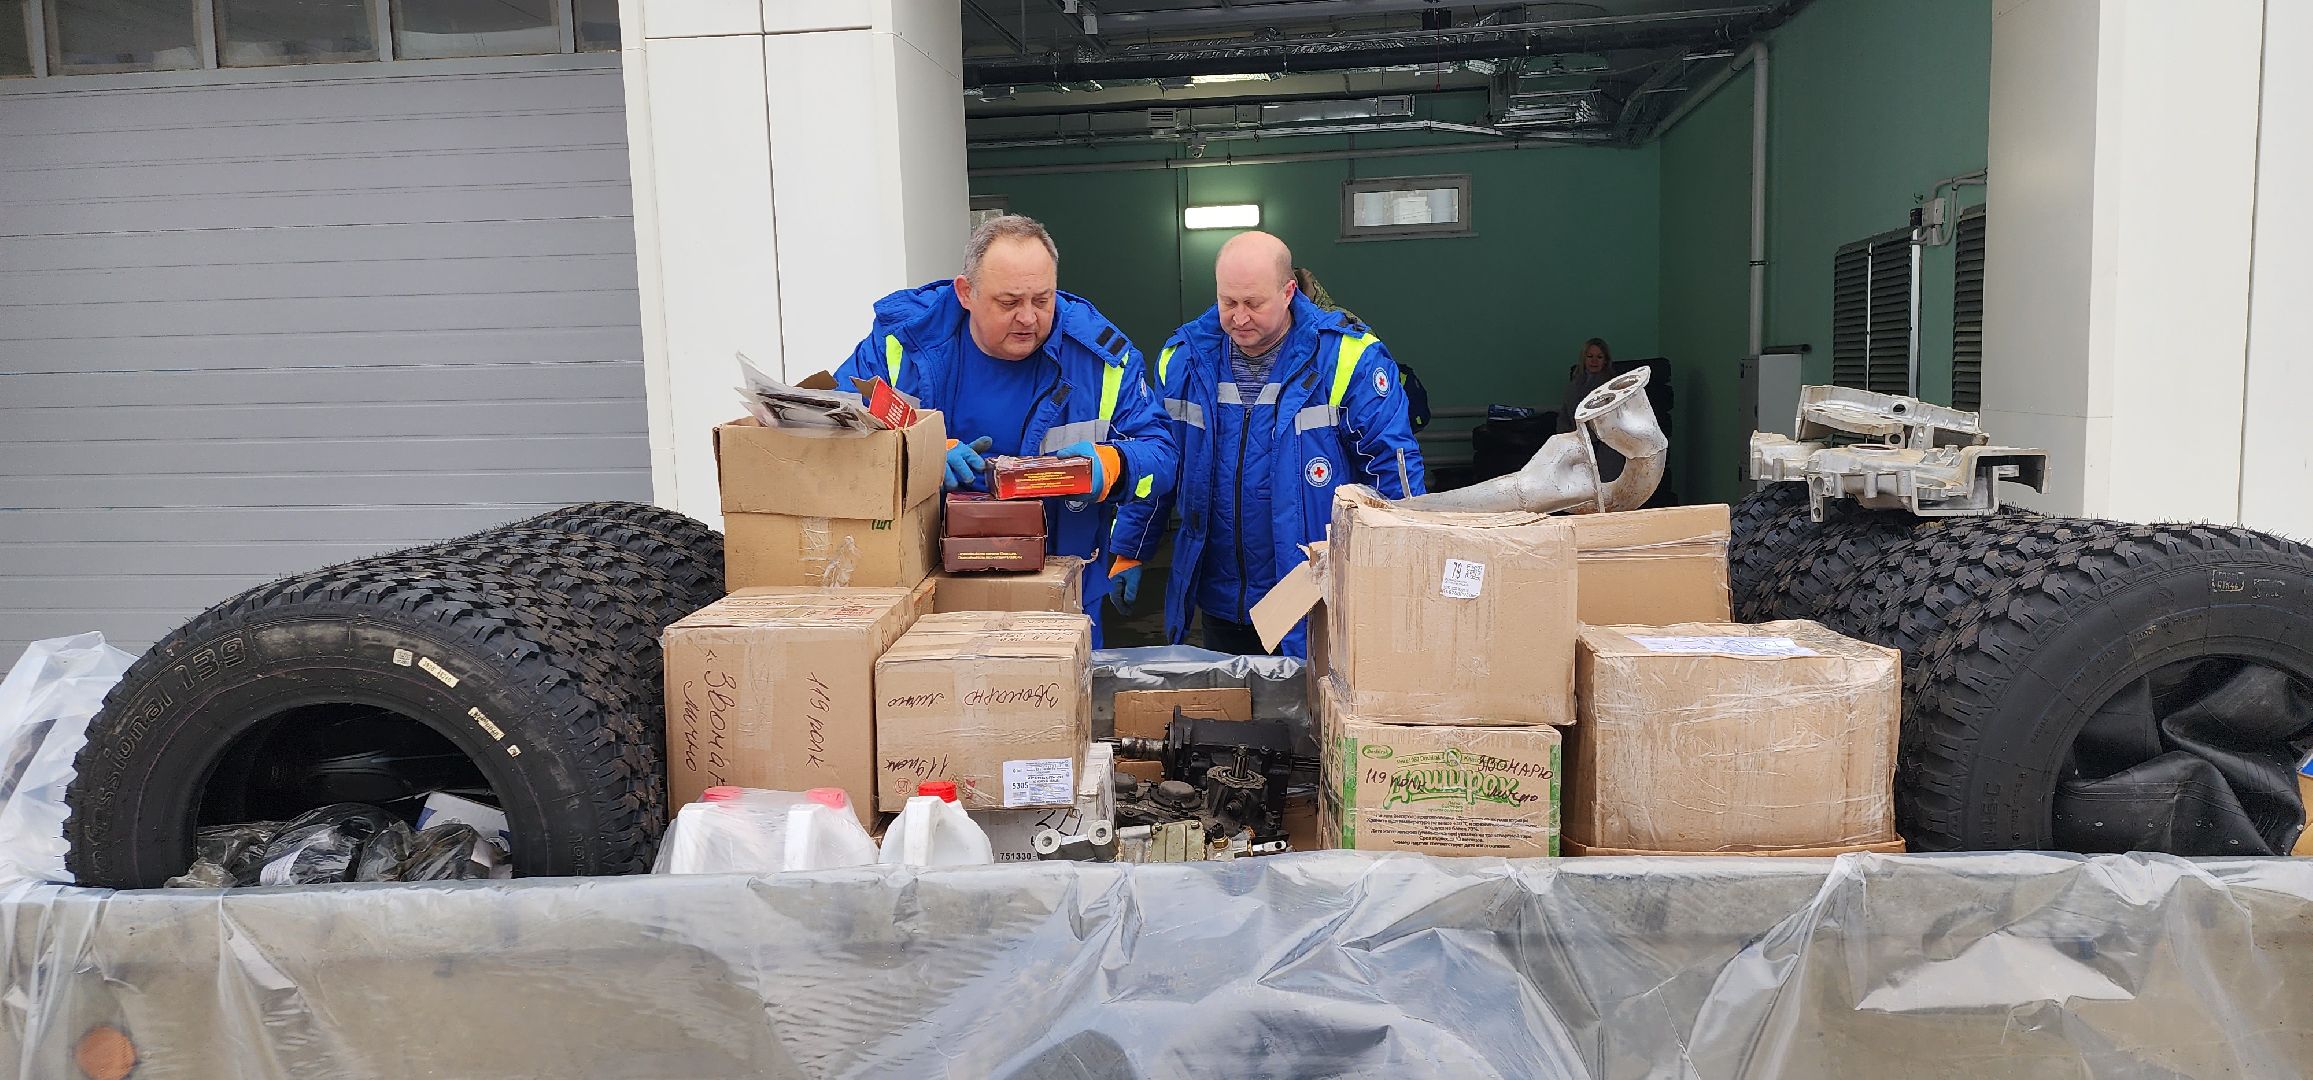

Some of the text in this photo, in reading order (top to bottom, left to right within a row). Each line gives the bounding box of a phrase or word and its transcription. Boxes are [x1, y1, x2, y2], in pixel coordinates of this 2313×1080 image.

[175, 637, 247, 692] 139
[805, 671, 831, 713] 119
[1365, 768, 1387, 784] 119
[1000, 852, 1041, 861] 751330-
